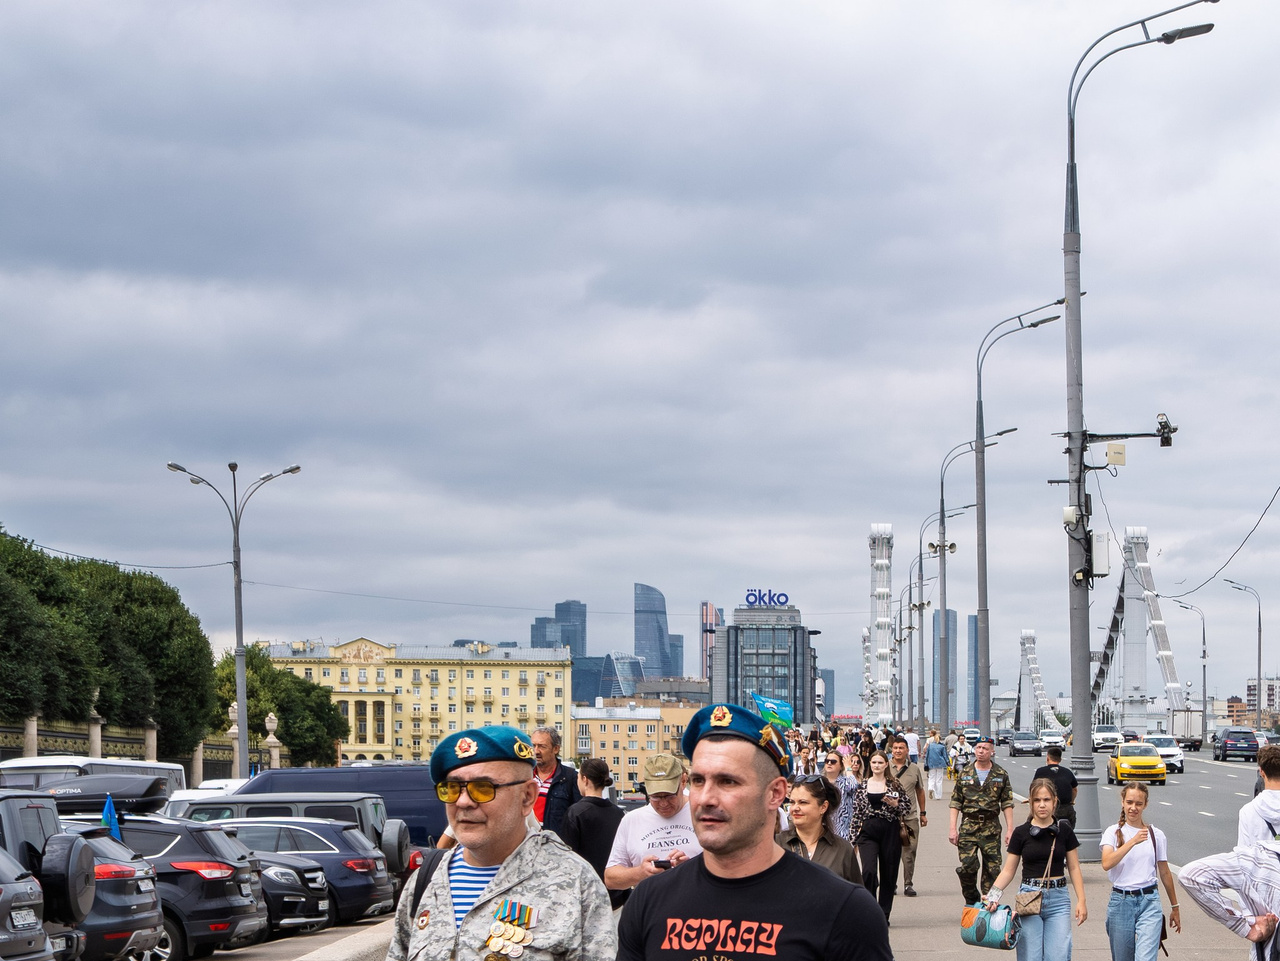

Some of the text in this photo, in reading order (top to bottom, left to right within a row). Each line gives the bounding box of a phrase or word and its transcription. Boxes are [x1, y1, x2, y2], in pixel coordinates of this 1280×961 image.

[641, 825, 669, 842] MUSTANG
[647, 840, 675, 849] JEANS
[661, 918, 783, 955] REPLAY
